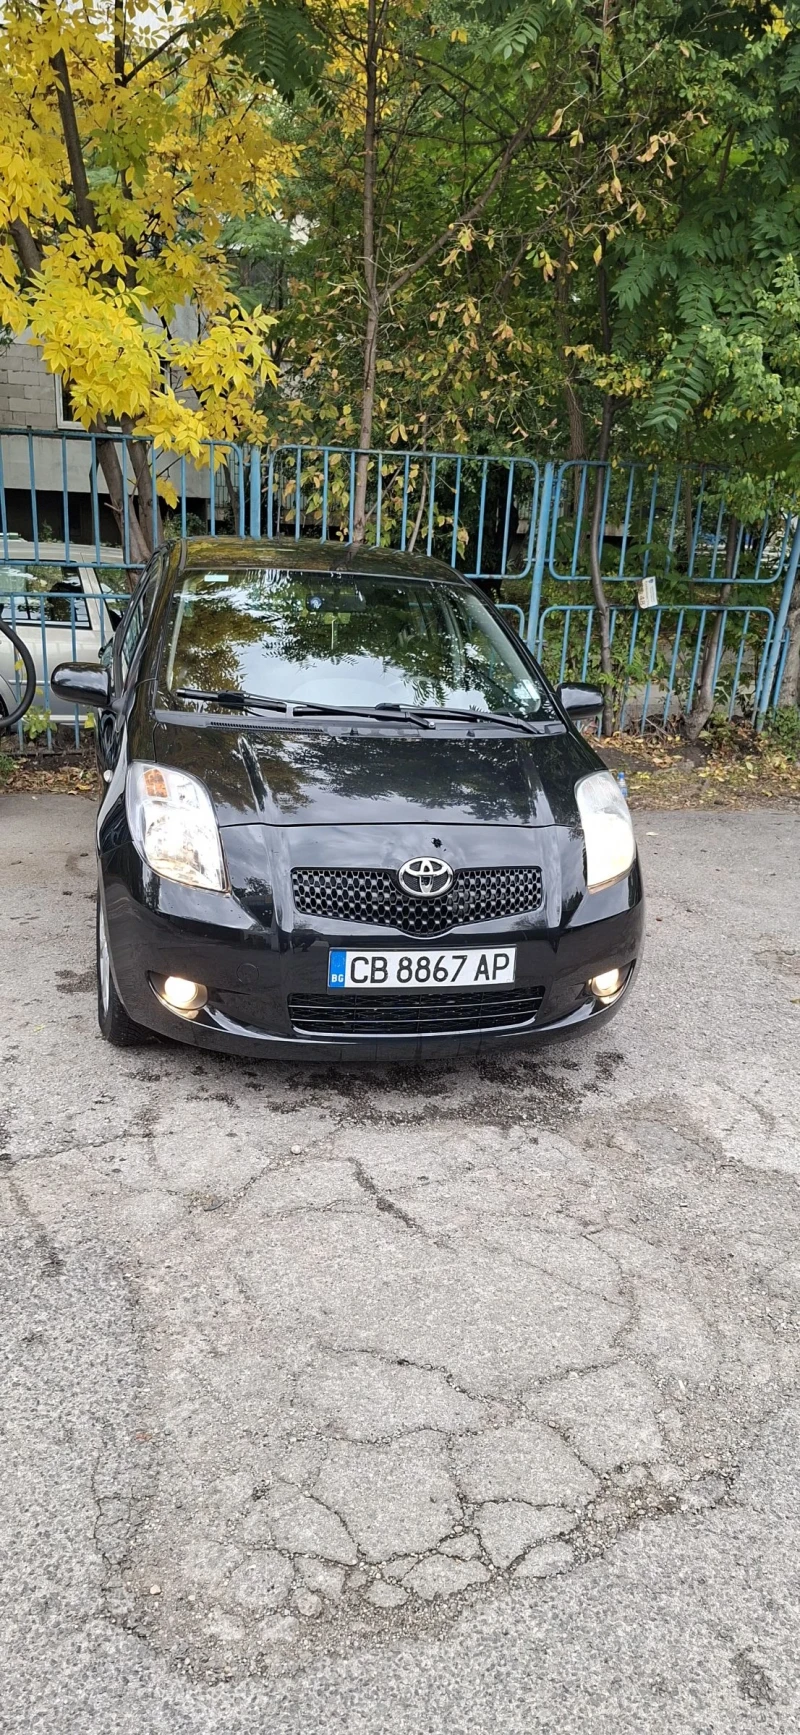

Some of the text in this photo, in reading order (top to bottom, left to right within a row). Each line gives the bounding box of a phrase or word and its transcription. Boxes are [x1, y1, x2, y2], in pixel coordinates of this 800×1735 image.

[331, 974, 344, 983] BG
[350, 953, 510, 984] CB 8867 AP
